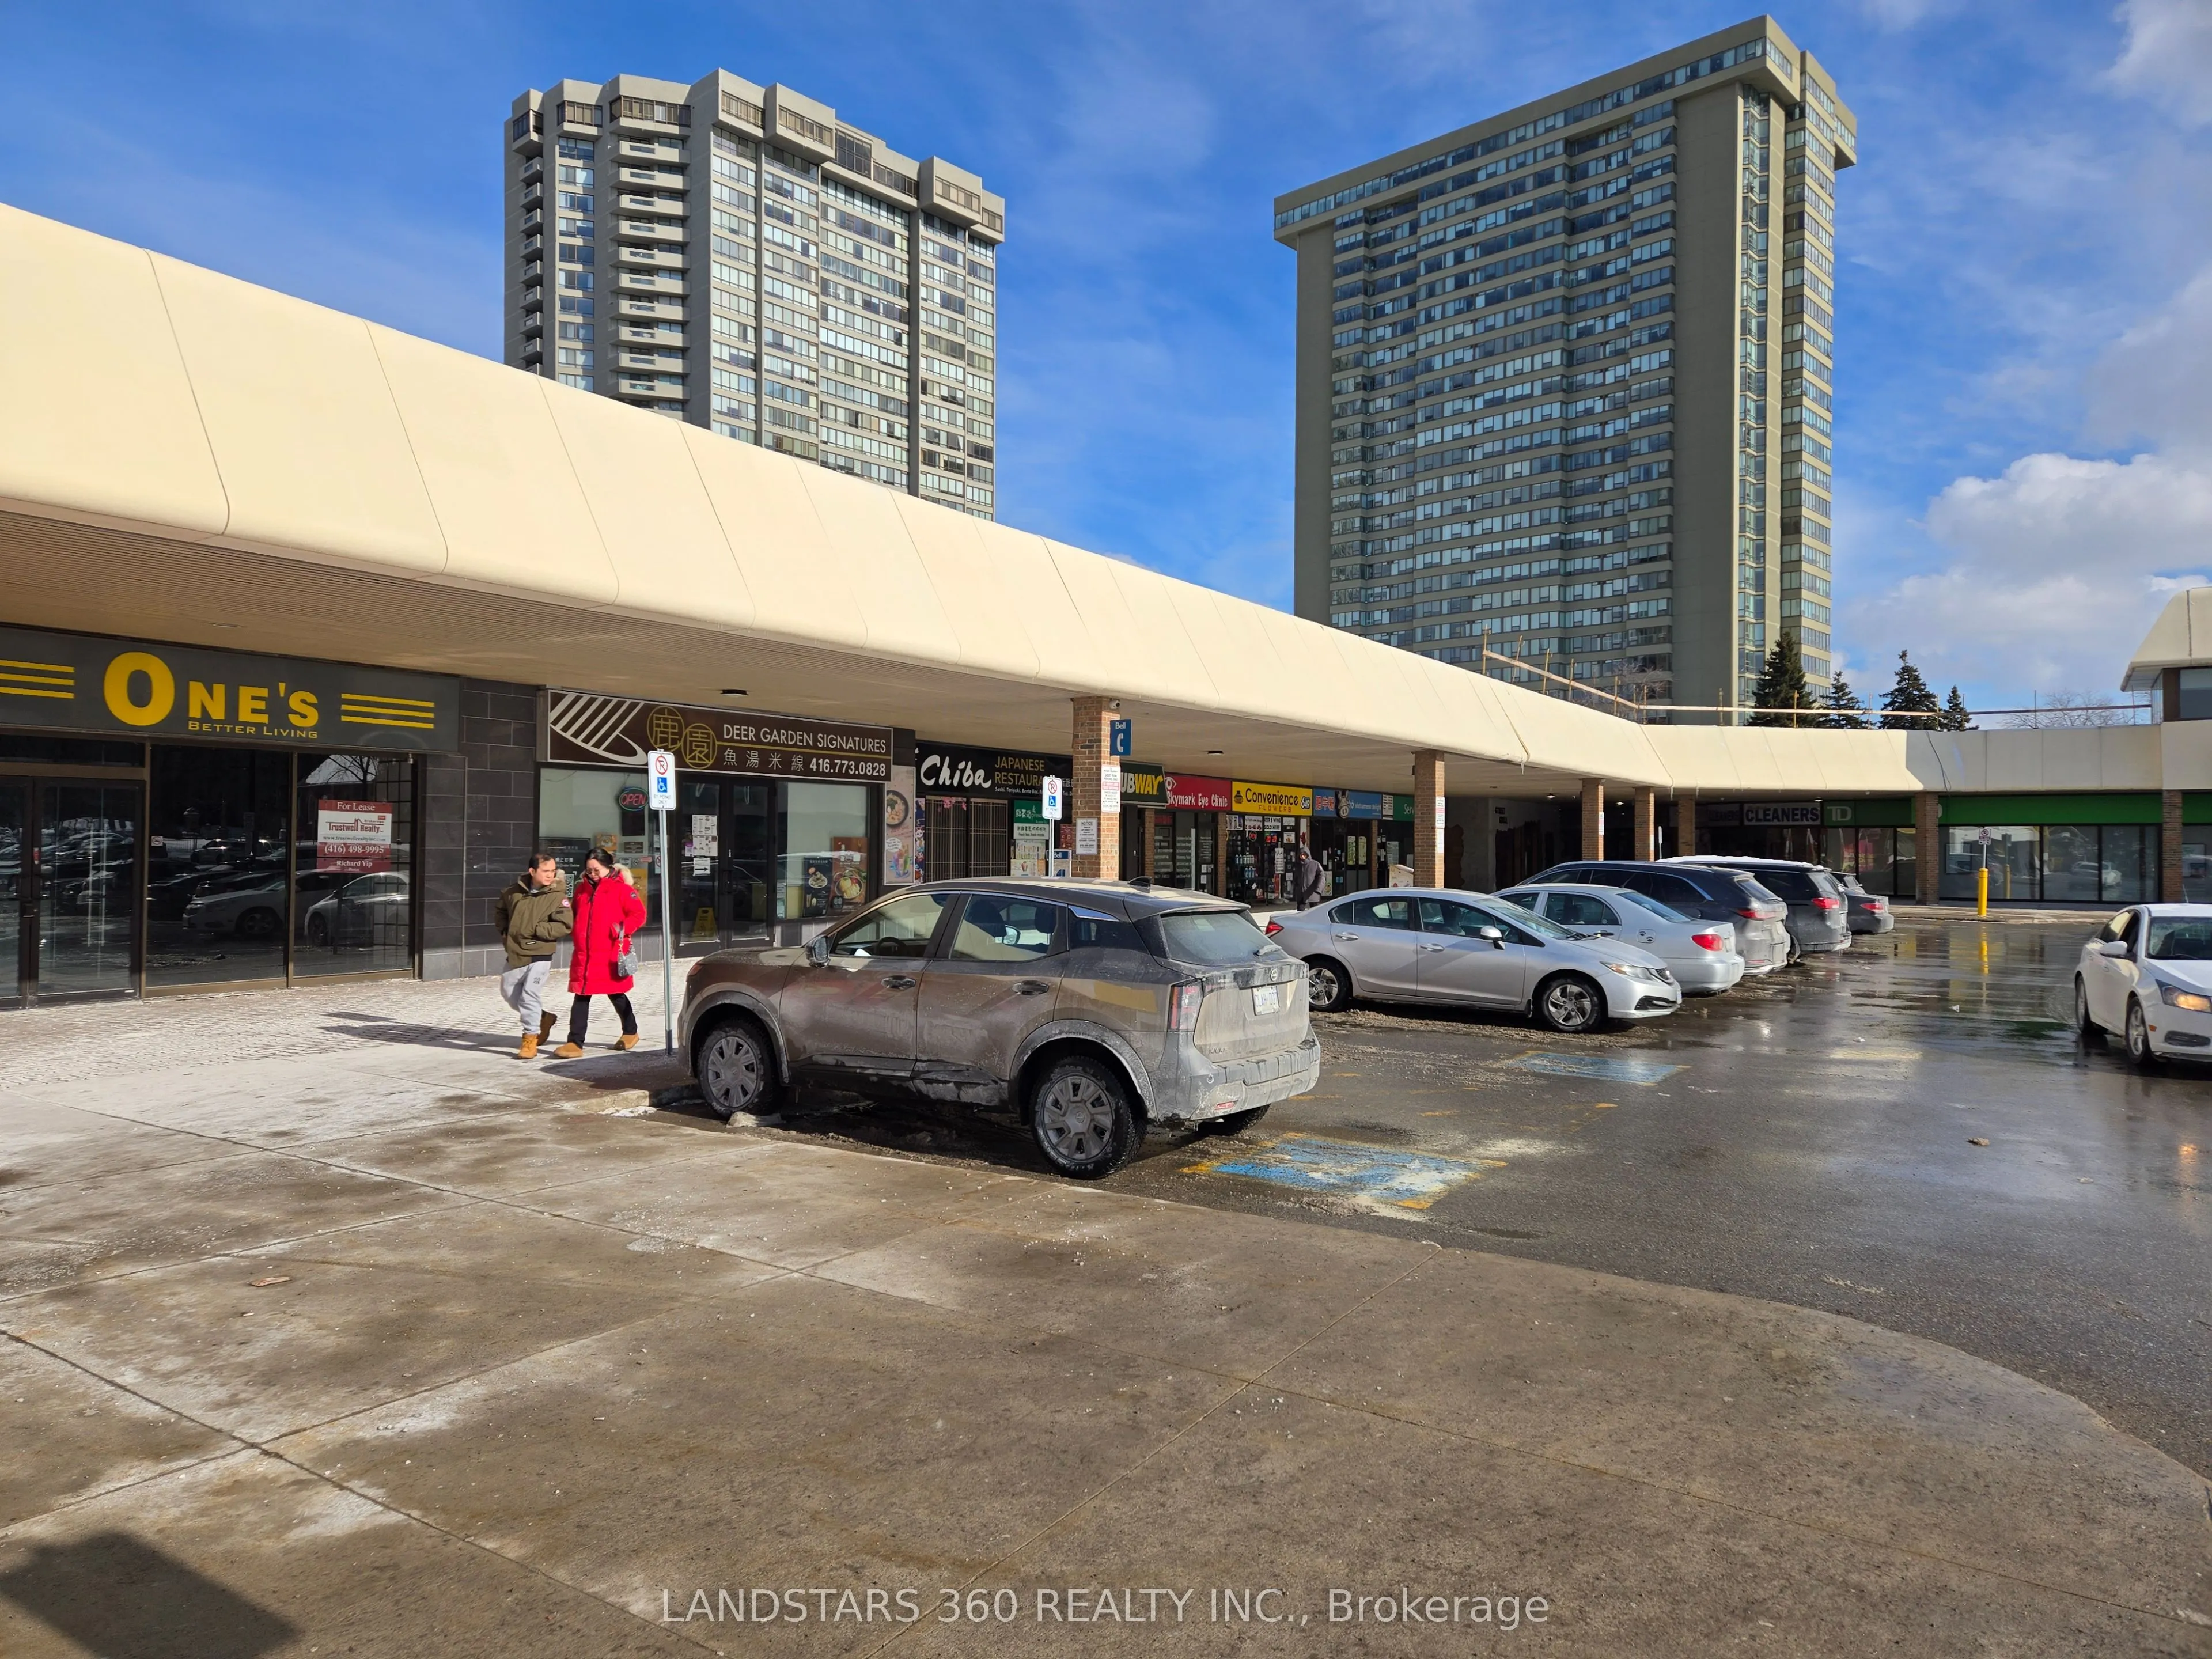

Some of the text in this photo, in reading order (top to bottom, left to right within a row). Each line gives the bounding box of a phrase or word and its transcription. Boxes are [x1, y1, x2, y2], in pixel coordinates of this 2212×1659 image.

[104, 652, 319, 728] ONE'S
[724, 724, 887, 753] DEER GARDEN SIGNATURES
[723, 748, 804, 772] 魚湯米線
[809, 757, 887, 777] 416.773.0828
[995, 756, 1045, 772] JAPANESE
[921, 755, 991, 789] Chiba
[995, 772, 1043, 787] RESTAURA
[1120, 772, 1163, 795] UBWAY
[621, 794, 646, 805] OPEN
[1167, 791, 1228, 808] Skymark Eye Clinic
[1245, 788, 1298, 806] Convenience
[337, 801, 376, 811] For Lease
[1258, 805, 1292, 813] FLOWERS
[1827, 807, 1852, 821] TD
[1745, 807, 1820, 823] CLEANERS
[328, 820, 380, 833] Trustwell Realty
[324, 843, 384, 854] (416) 498-9995
